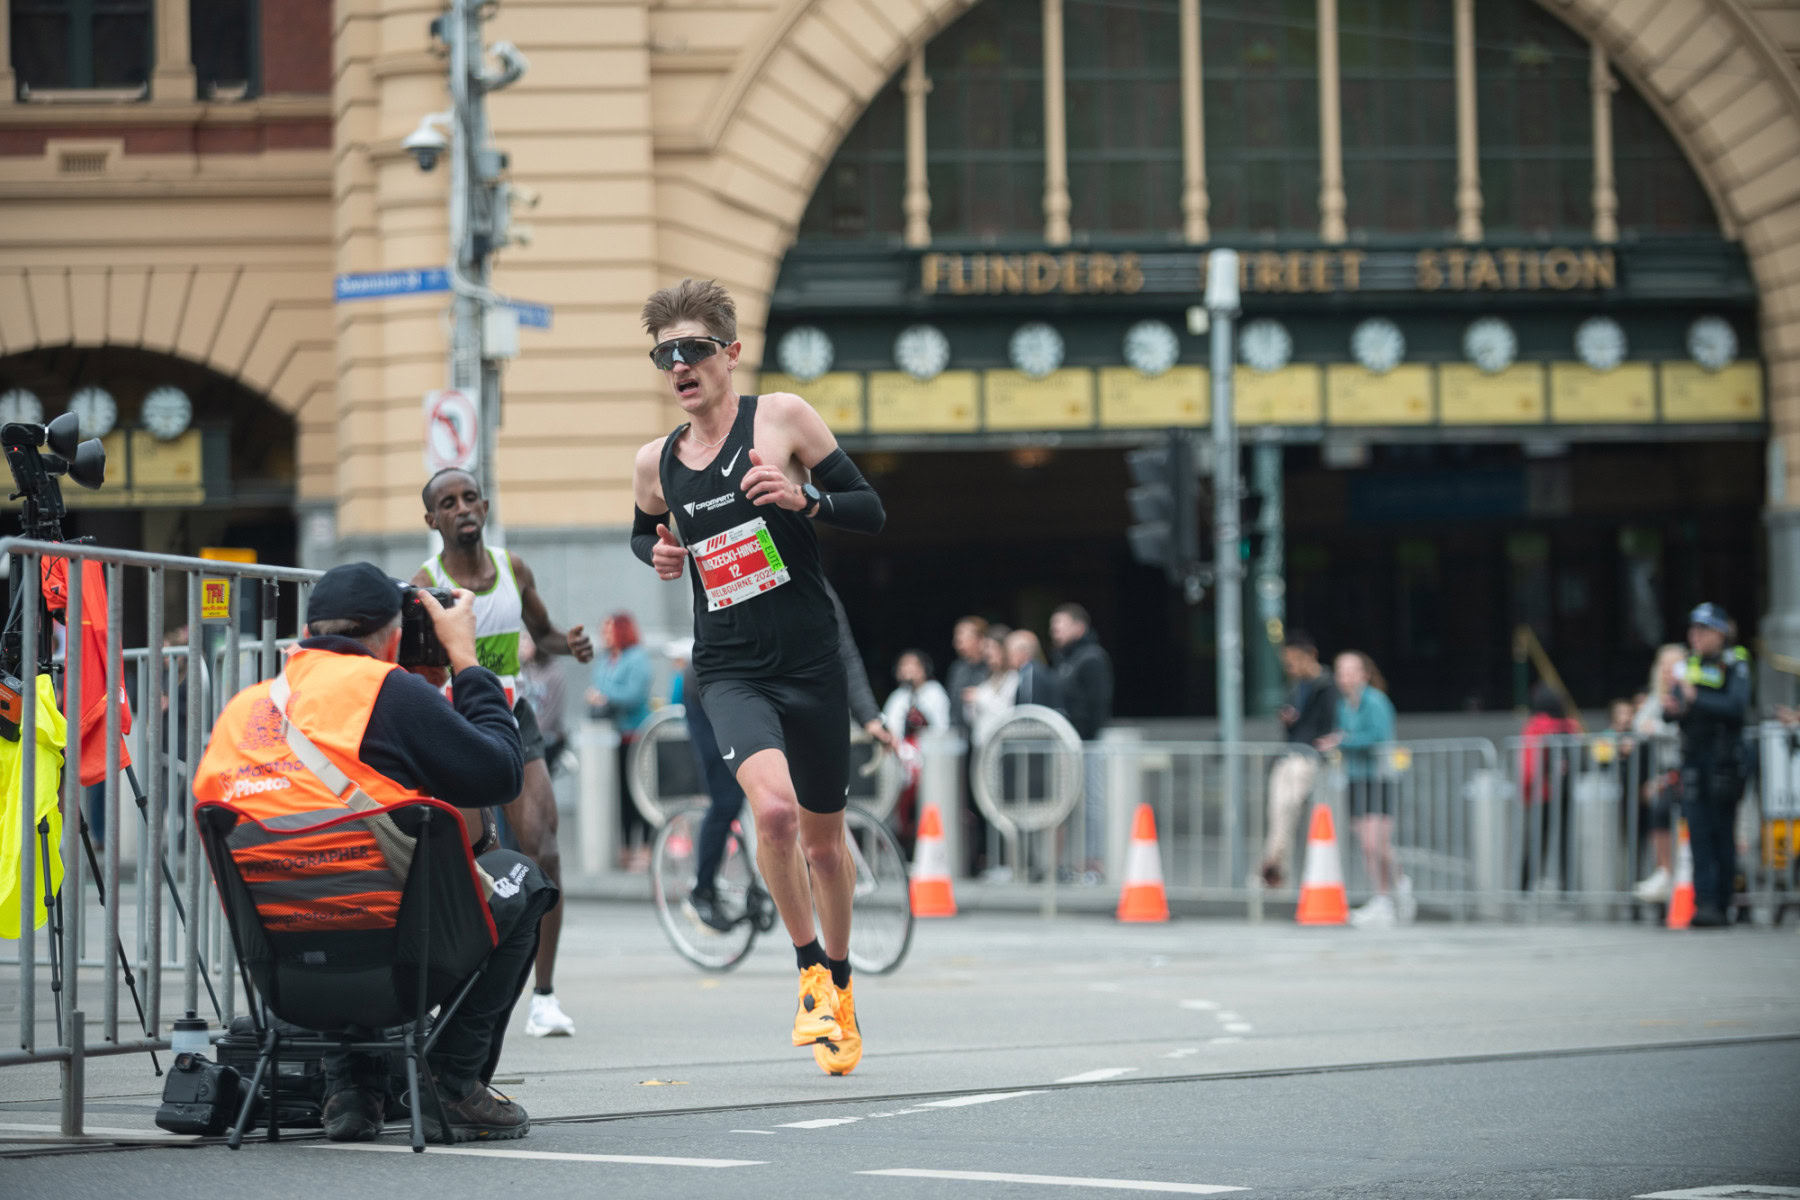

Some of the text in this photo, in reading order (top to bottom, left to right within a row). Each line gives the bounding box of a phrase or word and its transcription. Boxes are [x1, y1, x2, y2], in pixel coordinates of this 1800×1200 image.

[922, 248, 1618, 295] FLINDERS TREET STATION
[695, 492, 735, 510] CROMARTY
[765, 545, 781, 570] ELITE
[728, 563, 743, 579] 12
[711, 577, 754, 599] MELBOURNE
[236, 759, 305, 780] Maratho
[235, 776, 292, 798] Photos
[245, 845, 369, 876] PHOTOGRAPHER
